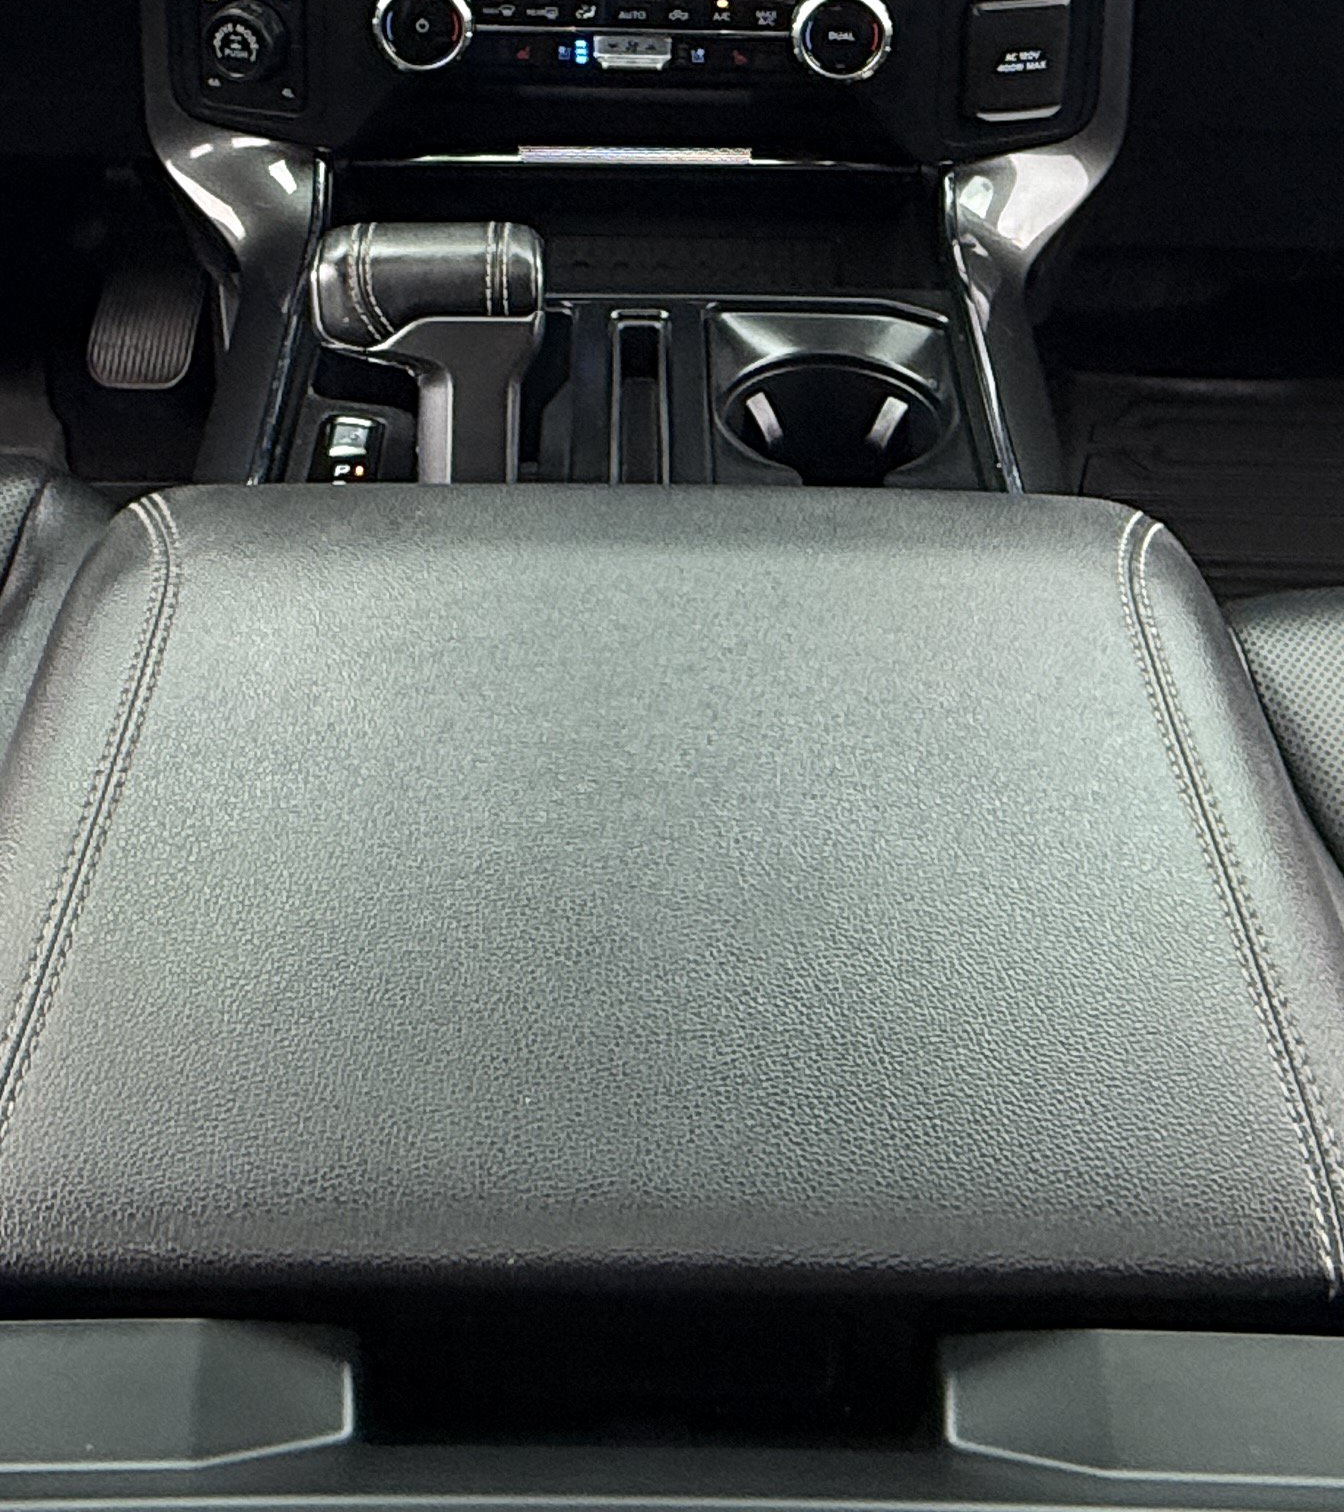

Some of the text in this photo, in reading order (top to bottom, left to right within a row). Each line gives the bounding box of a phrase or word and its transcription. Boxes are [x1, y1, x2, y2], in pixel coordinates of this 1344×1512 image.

[617, 10, 648, 20] AUTO
[713, 11, 732, 22] A/C
[224, 48, 249, 59] PUSH
[334, 463, 350, 477] P
